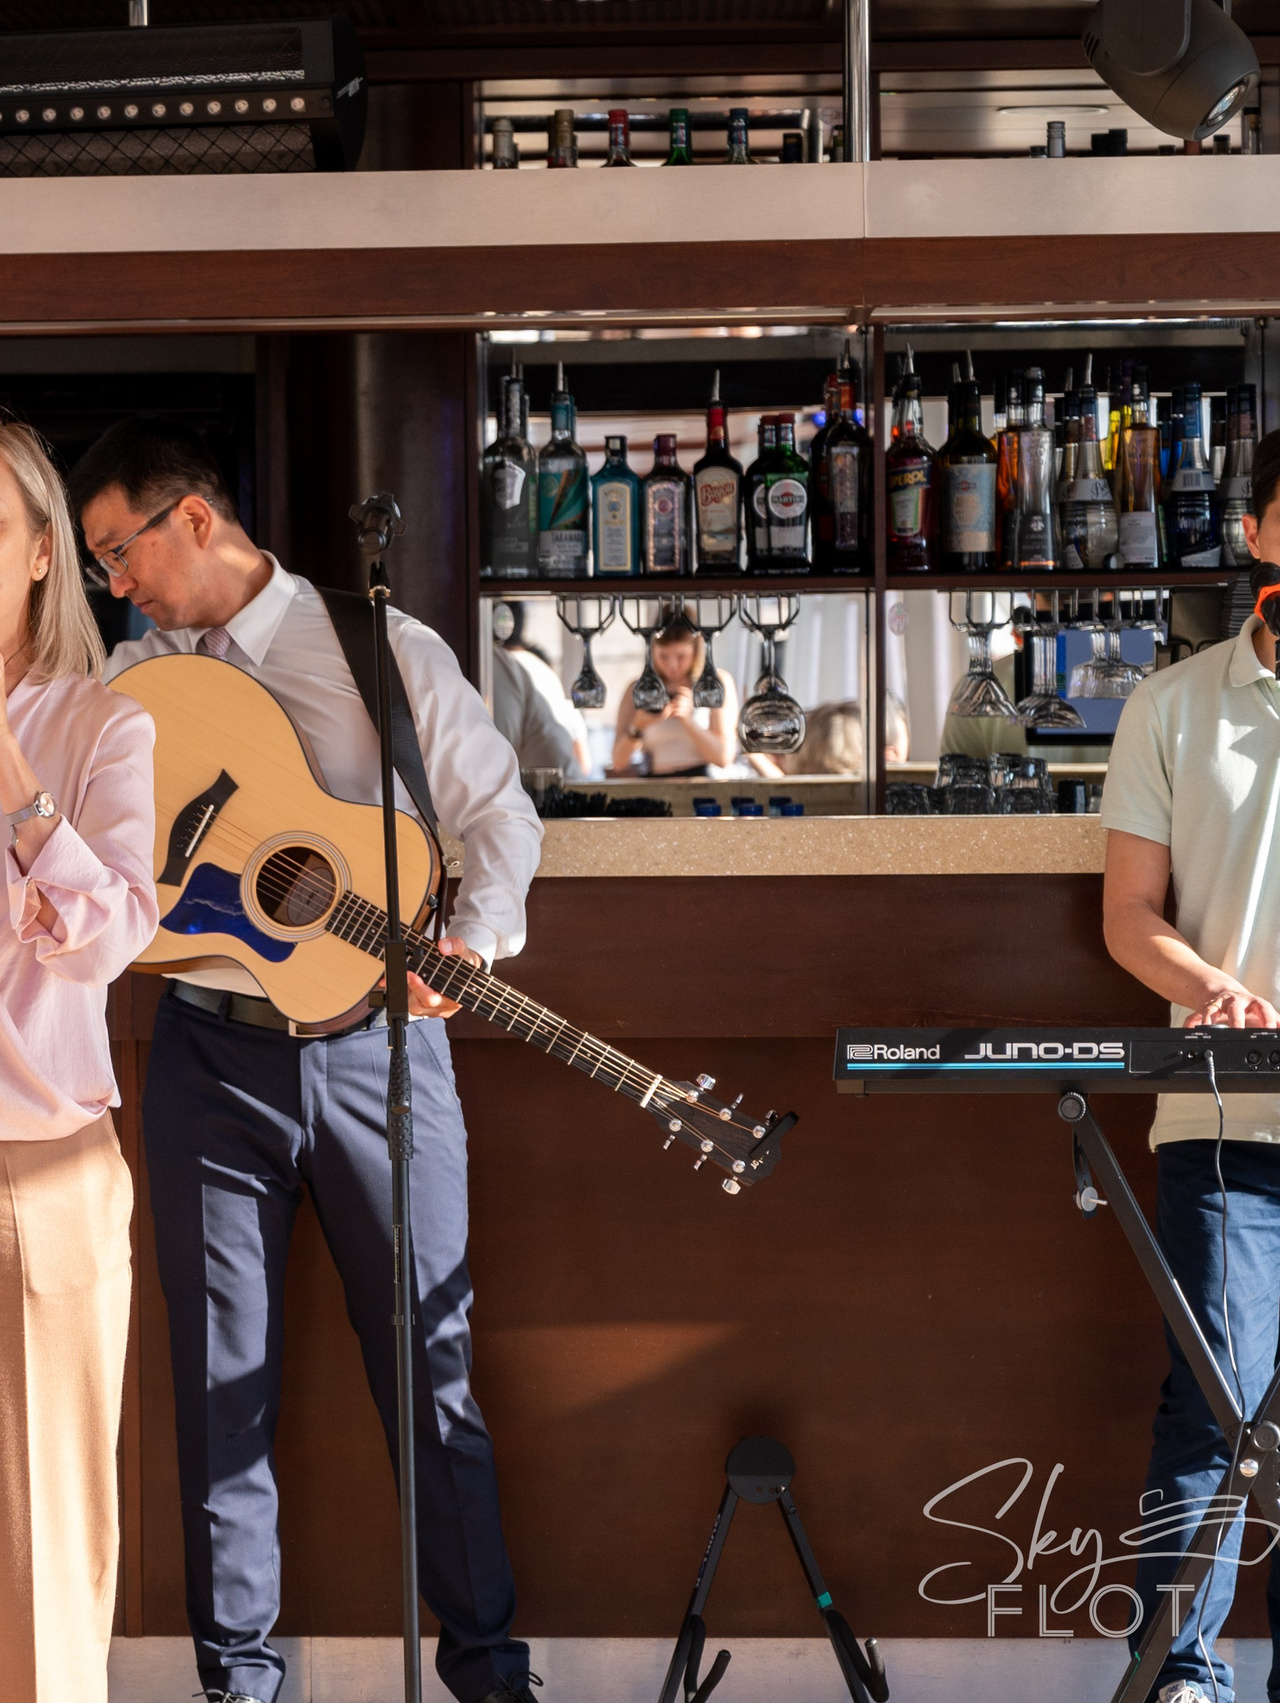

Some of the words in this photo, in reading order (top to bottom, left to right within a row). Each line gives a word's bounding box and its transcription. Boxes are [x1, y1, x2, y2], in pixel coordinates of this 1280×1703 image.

[771, 494, 805, 504] MARTINI
[874, 1043, 941, 1061] Roland
[964, 1041, 1126, 1060] JUNO-DS
